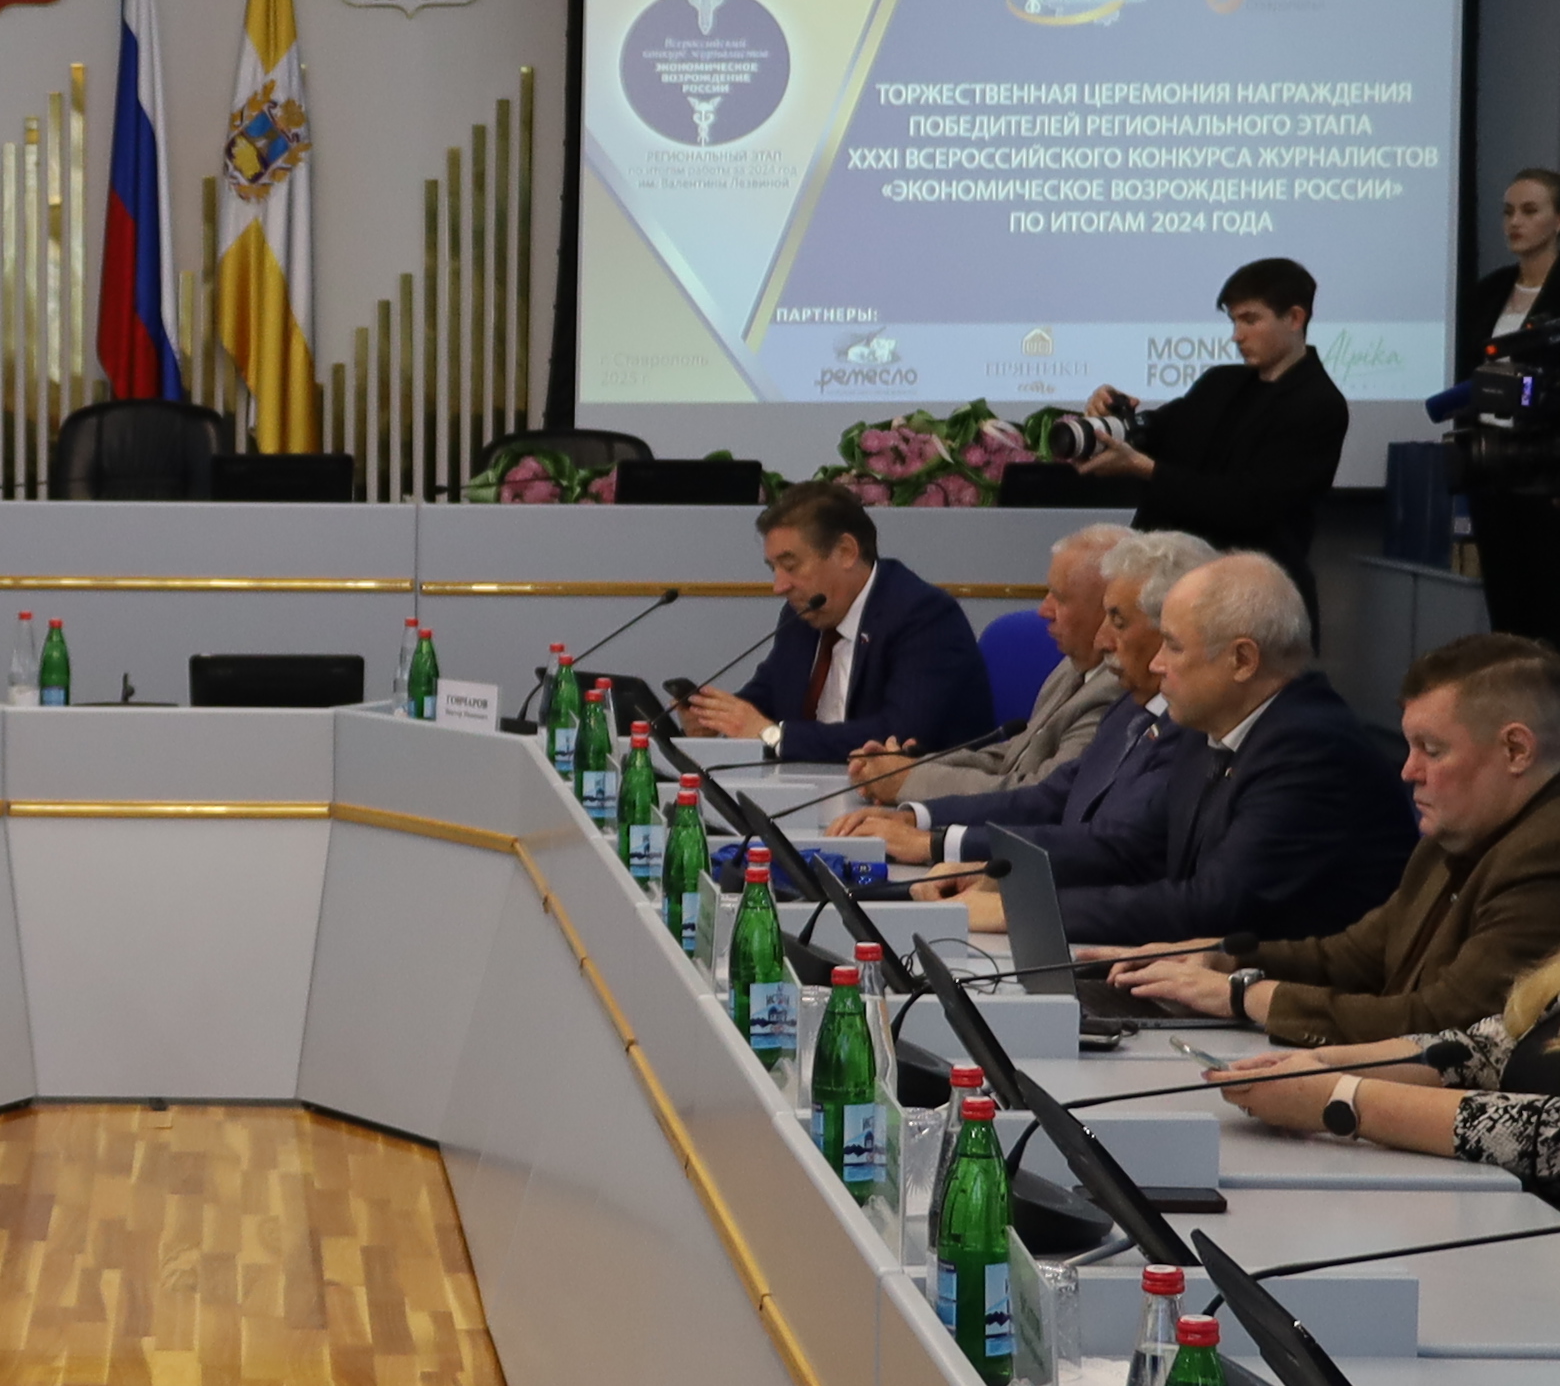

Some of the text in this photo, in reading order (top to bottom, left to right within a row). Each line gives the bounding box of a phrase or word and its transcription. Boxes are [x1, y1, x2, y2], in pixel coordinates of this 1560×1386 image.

[655, 62, 759, 73] ЭКОНОМИЧЕСКОЕ
[660, 73, 751, 84] ВОЗРОЖДЕНИЕ
[682, 84, 730, 94] РОССИИ
[876, 82, 1413, 109] ТОРЖЕСТВЕННАЯ ЦЕРЕМОНИЯ НАГРАЖДЕНИЯ
[909, 112, 1373, 140] ПОБЕДИТЕЛЕЙ РЕГИОНАЛЬНОГО ЭТАПА
[646, 150, 783, 162] РЕГИОНАЛЬНЫЙ ЭТАП
[848, 144, 1440, 170] XXXI ВСЕРОССИЙСКОГО КОНКУРСА ЖУРНАЛИСТОВ
[881, 178, 1404, 204] «ЭКОНОМИЧЕСКОЕ ВОЗРОЖДЕНИЕ РОССИИ»
[1010, 211, 1274, 237] ПО ИТОГАМ 2024 ГОДА
[776, 307, 879, 323] ПАРТНЕРЫ:
[613, 353, 710, 369] Ставрополь
[985, 361, 1089, 376] ПРЯНИКИ
[600, 370, 637, 385] 2025
